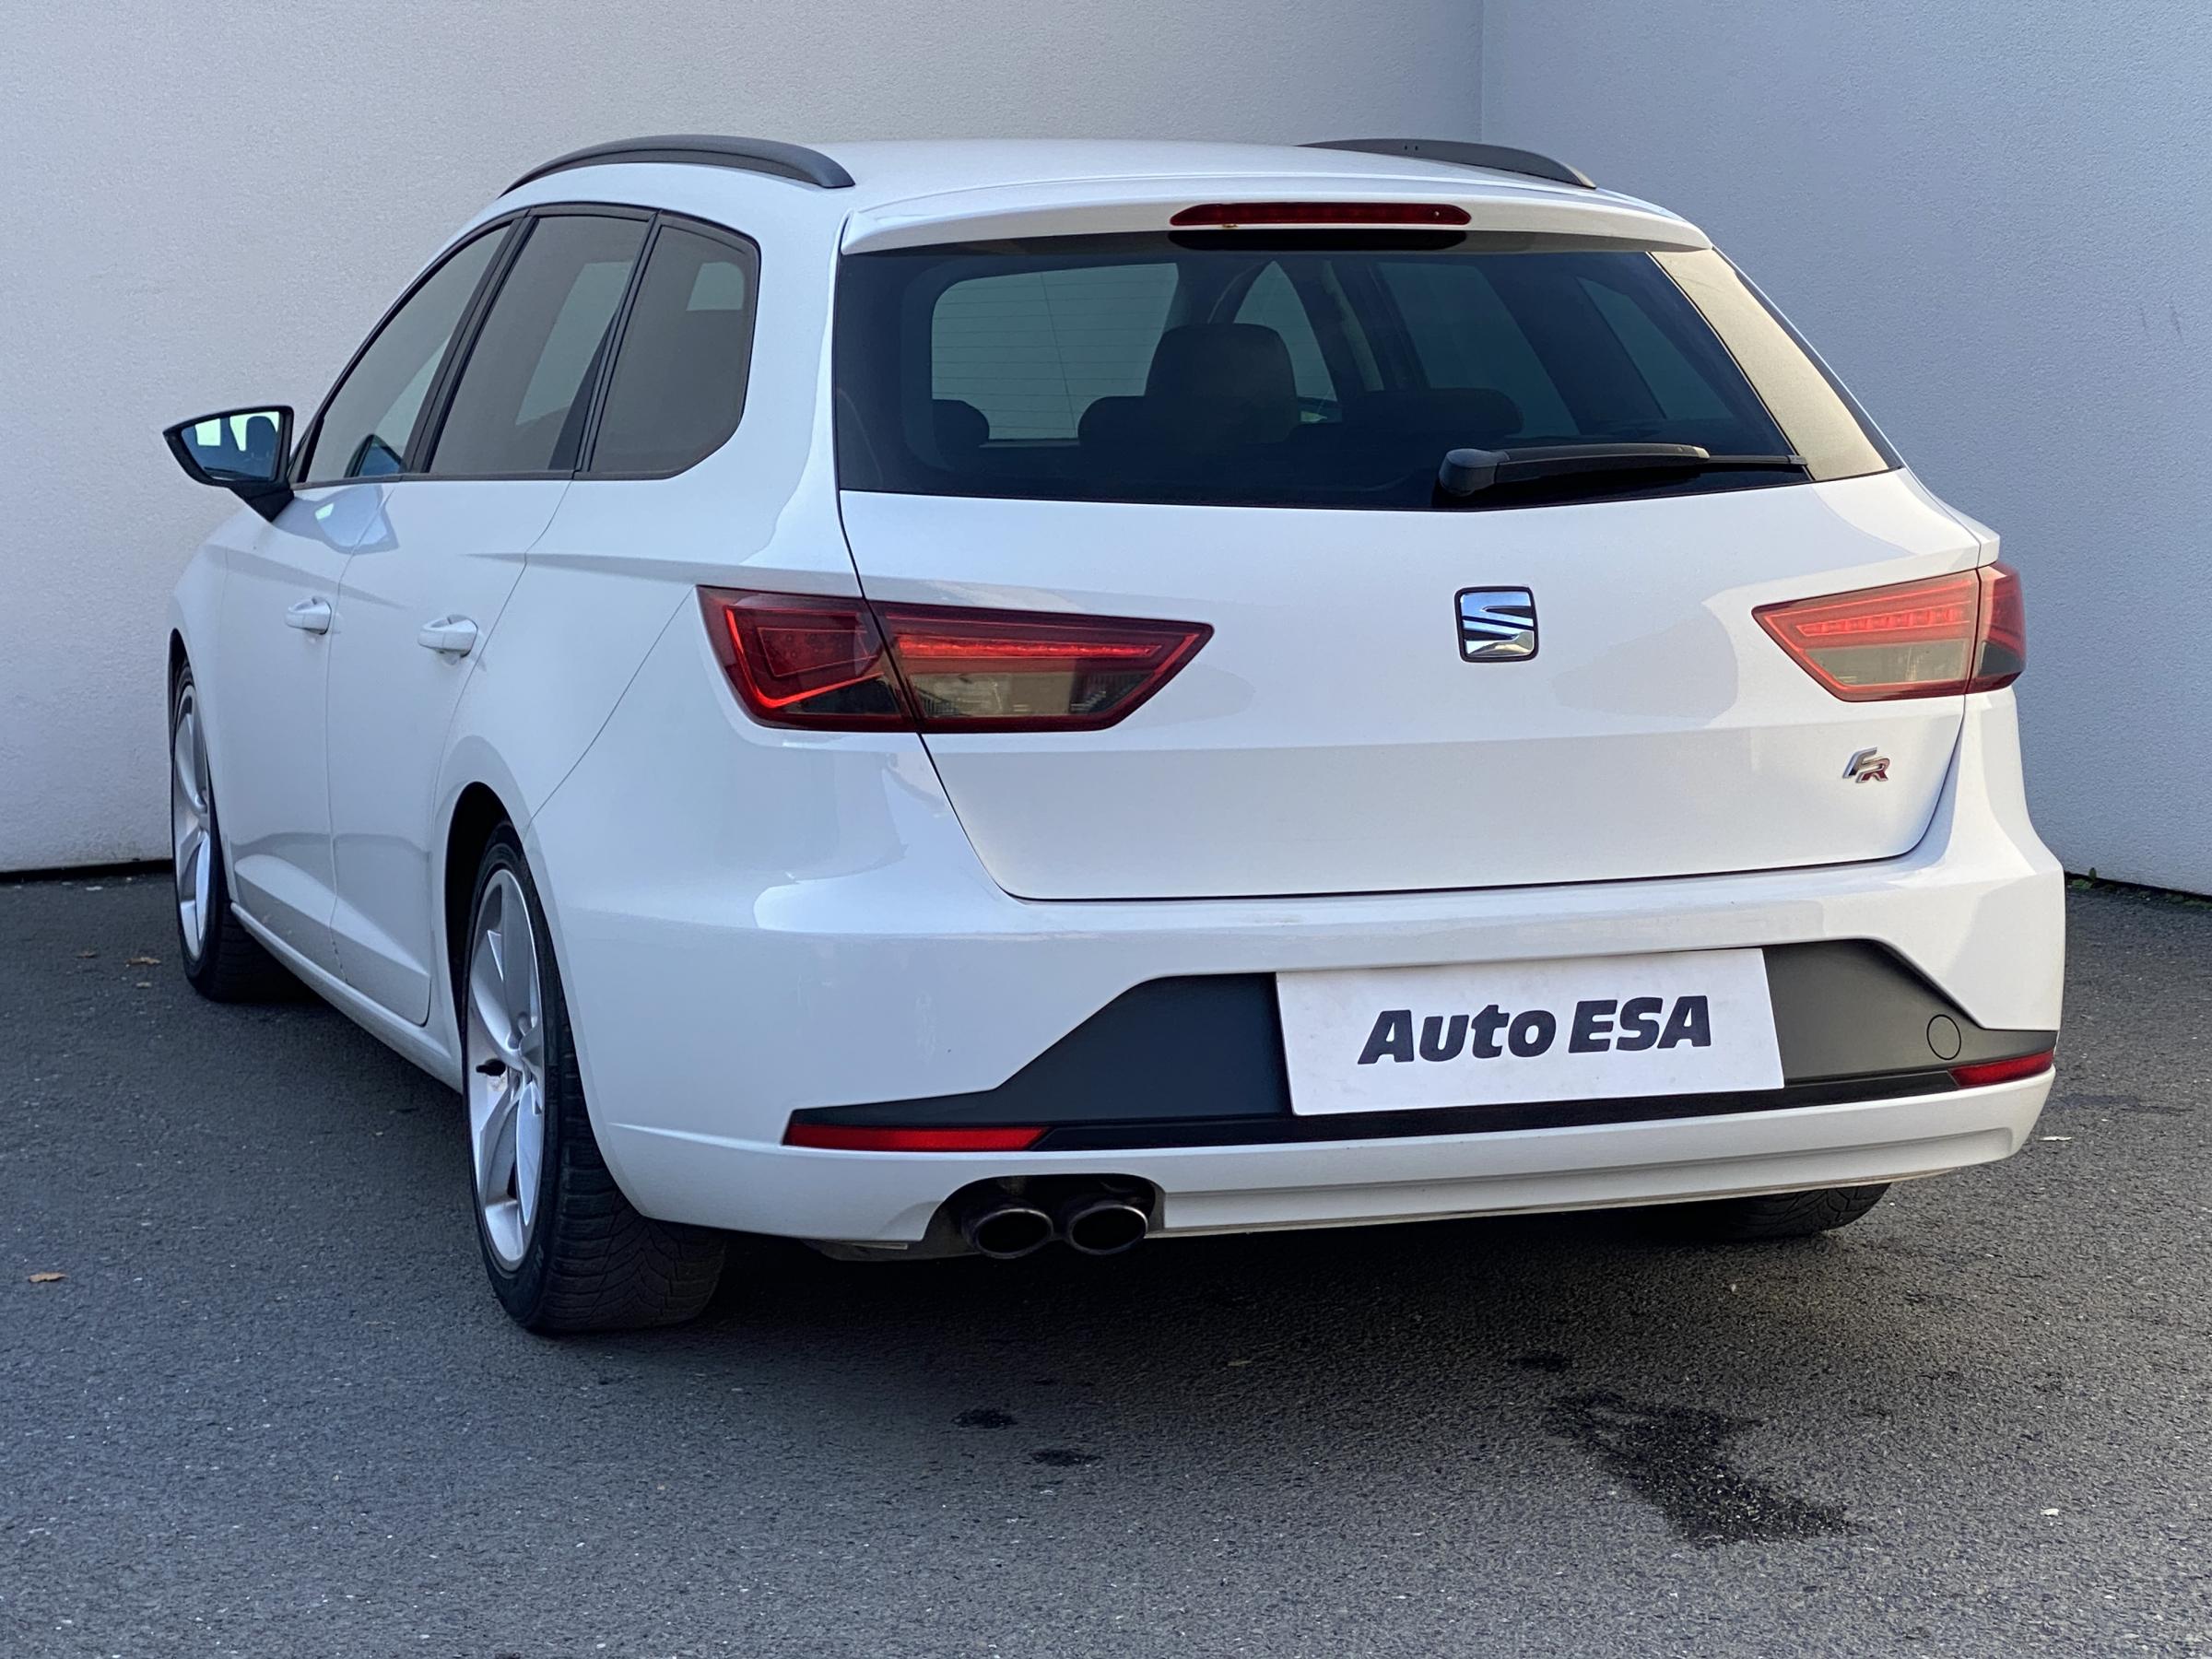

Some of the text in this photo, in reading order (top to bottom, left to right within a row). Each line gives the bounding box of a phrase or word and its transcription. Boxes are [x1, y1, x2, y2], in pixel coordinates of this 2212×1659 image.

[1842, 746, 1889, 783] FR
[1358, 995, 1712, 1065] Auto ESA
